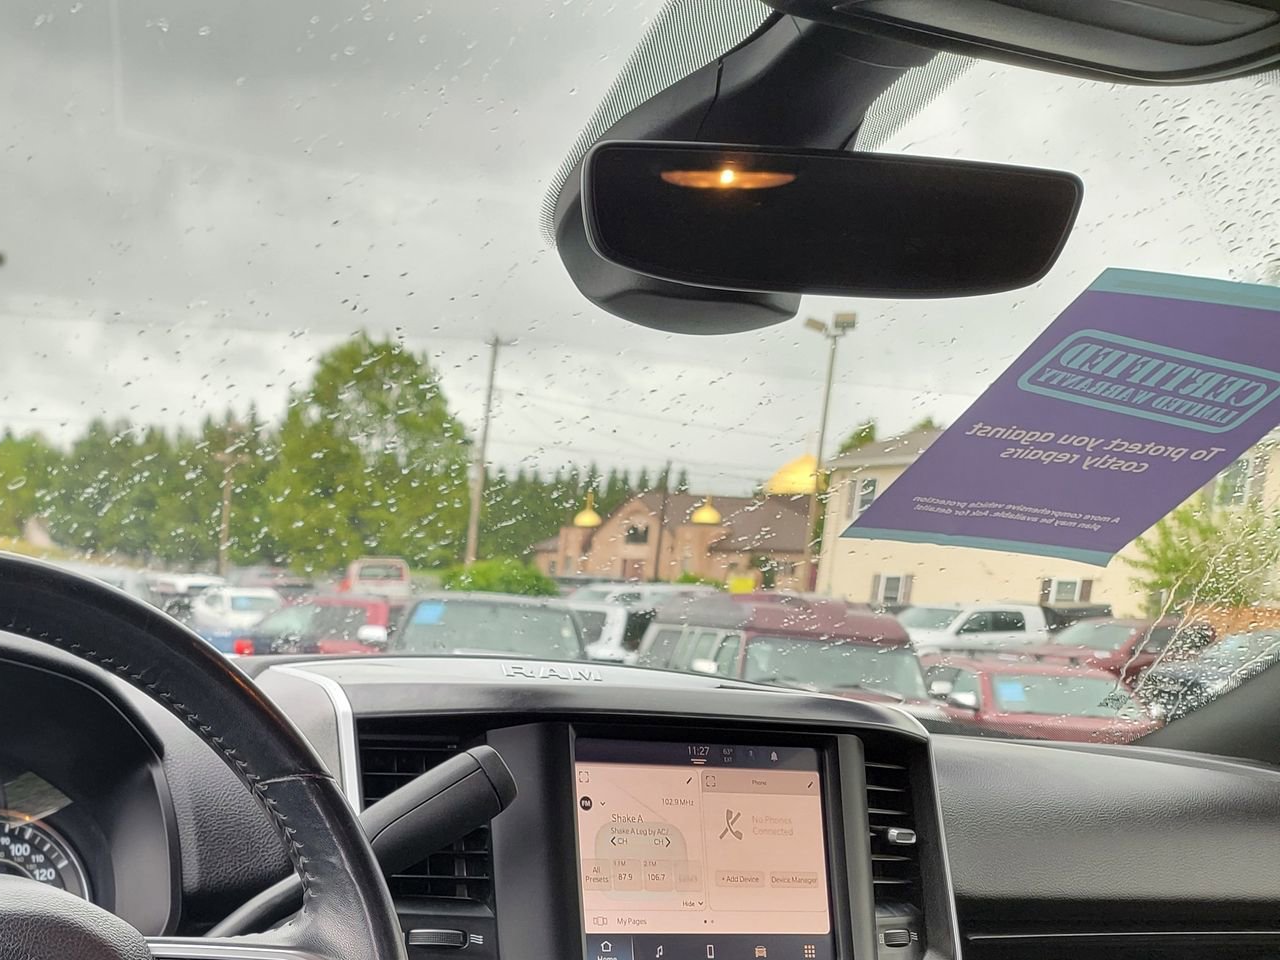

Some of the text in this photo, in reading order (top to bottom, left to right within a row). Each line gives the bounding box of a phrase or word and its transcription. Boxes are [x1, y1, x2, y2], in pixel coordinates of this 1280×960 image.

[501, 663, 603, 681] RAM
[688, 746, 710, 756] 11:27
[611, 814, 644, 824] Shake A
[0, 837, 11, 846] 90
[9, 844, 31, 857] 100
[31, 854, 44, 864] 110
[33, 868, 56, 881] 120
[618, 873, 633, 881] 87.9
[647, 873, 666, 881] 106.7
[627, 918, 647, 926] Pages
